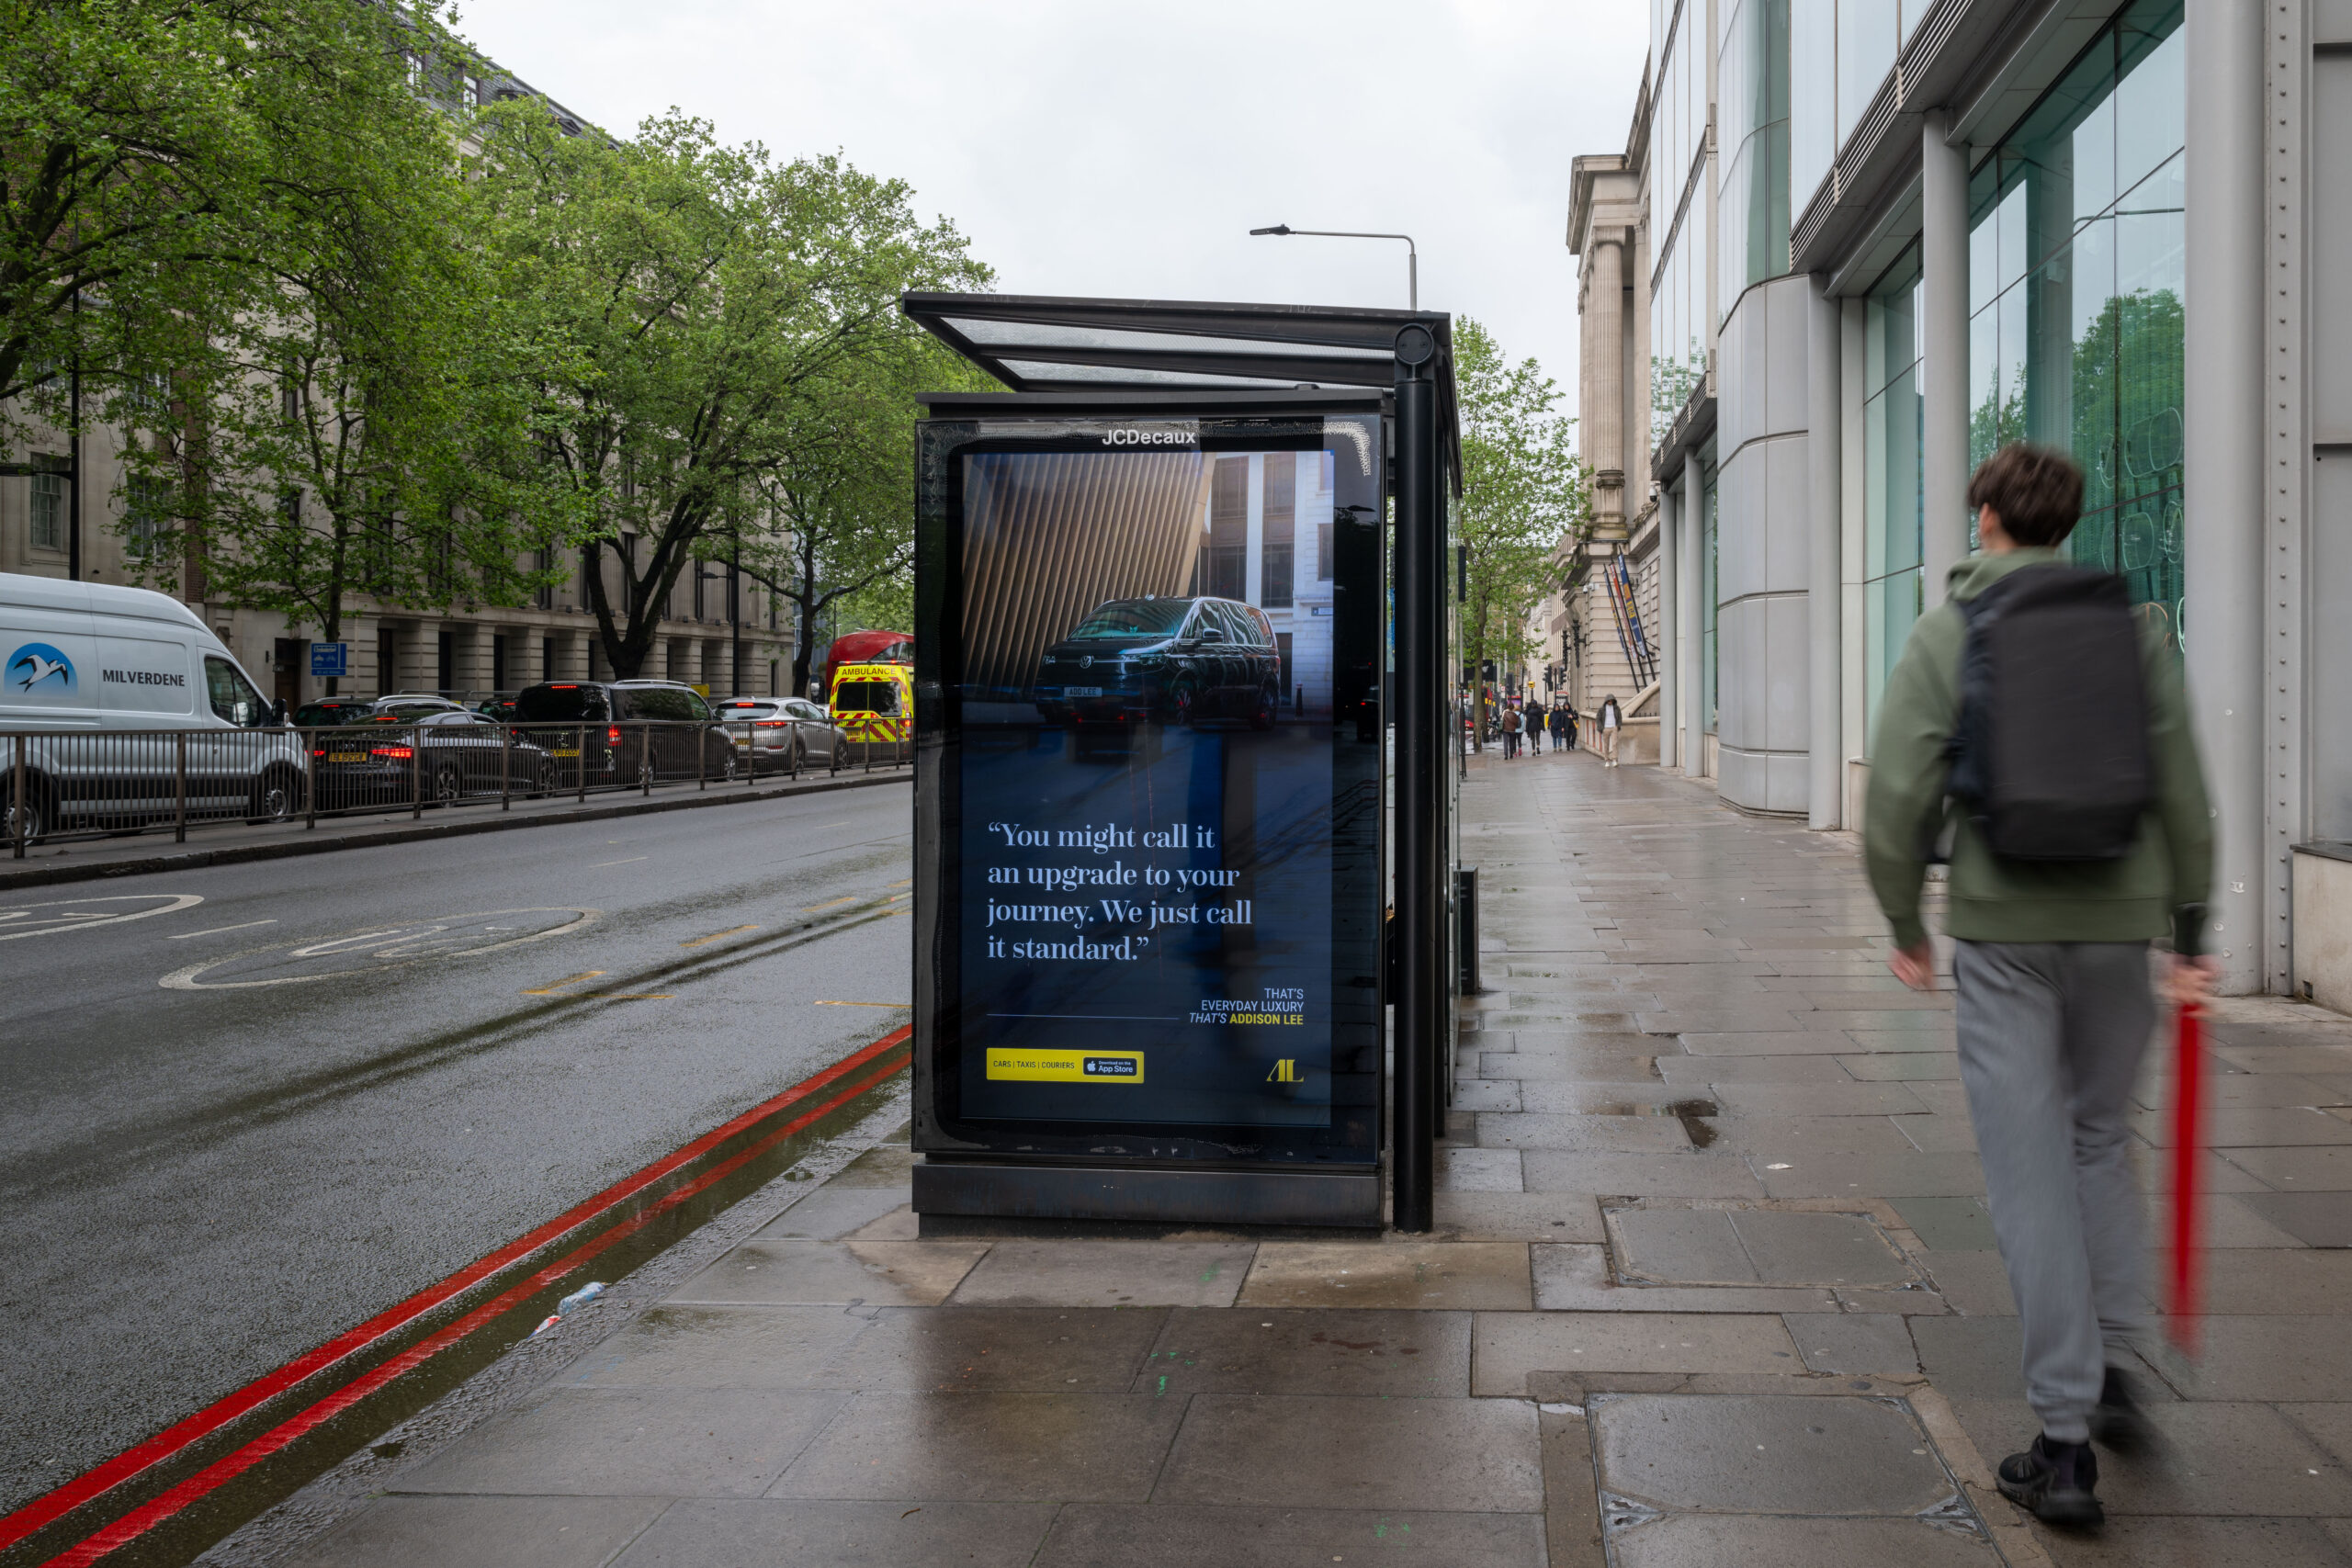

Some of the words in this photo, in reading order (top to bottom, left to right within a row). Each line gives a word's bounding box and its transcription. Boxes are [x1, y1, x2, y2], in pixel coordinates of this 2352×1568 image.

[1102, 429, 1196, 446] JCDecaux
[103, 669, 186, 687] MILVERDENE
[989, 821, 1050, 847] “You
[1057, 823, 1136, 854] might
[1143, 823, 1189, 848] call
[1195, 825, 1216, 849] it
[988, 866, 1021, 884] an
[1027, 861, 1137, 892] upgrade
[1146, 863, 1170, 886] to
[1176, 868, 1240, 893] your
[986, 897, 1094, 929] journey.
[1100, 899, 1142, 923] We
[1148, 900, 1200, 930] just
[1205, 899, 1252, 924] call
[987, 935, 1006, 958] it
[1012, 935, 1149, 961] standard.”
[1264, 987, 1304, 999] THAT'S
[1201, 999, 1258, 1011] EVERYDAY
[1261, 1000, 1304, 1012] LUXURY
[1189, 1012, 1227, 1024] THAT'S
[1229, 1013, 1281, 1025] ADDISON
[1283, 1014, 1304, 1025] LEE
[993, 1060, 1012, 1068] CARS
[1016, 1060, 1036, 1068] TAXIS
[1041, 1061, 1075, 1069] COURIERS
[1098, 1065, 1114, 1074] App
[1114, 1065, 1134, 1073] Store
